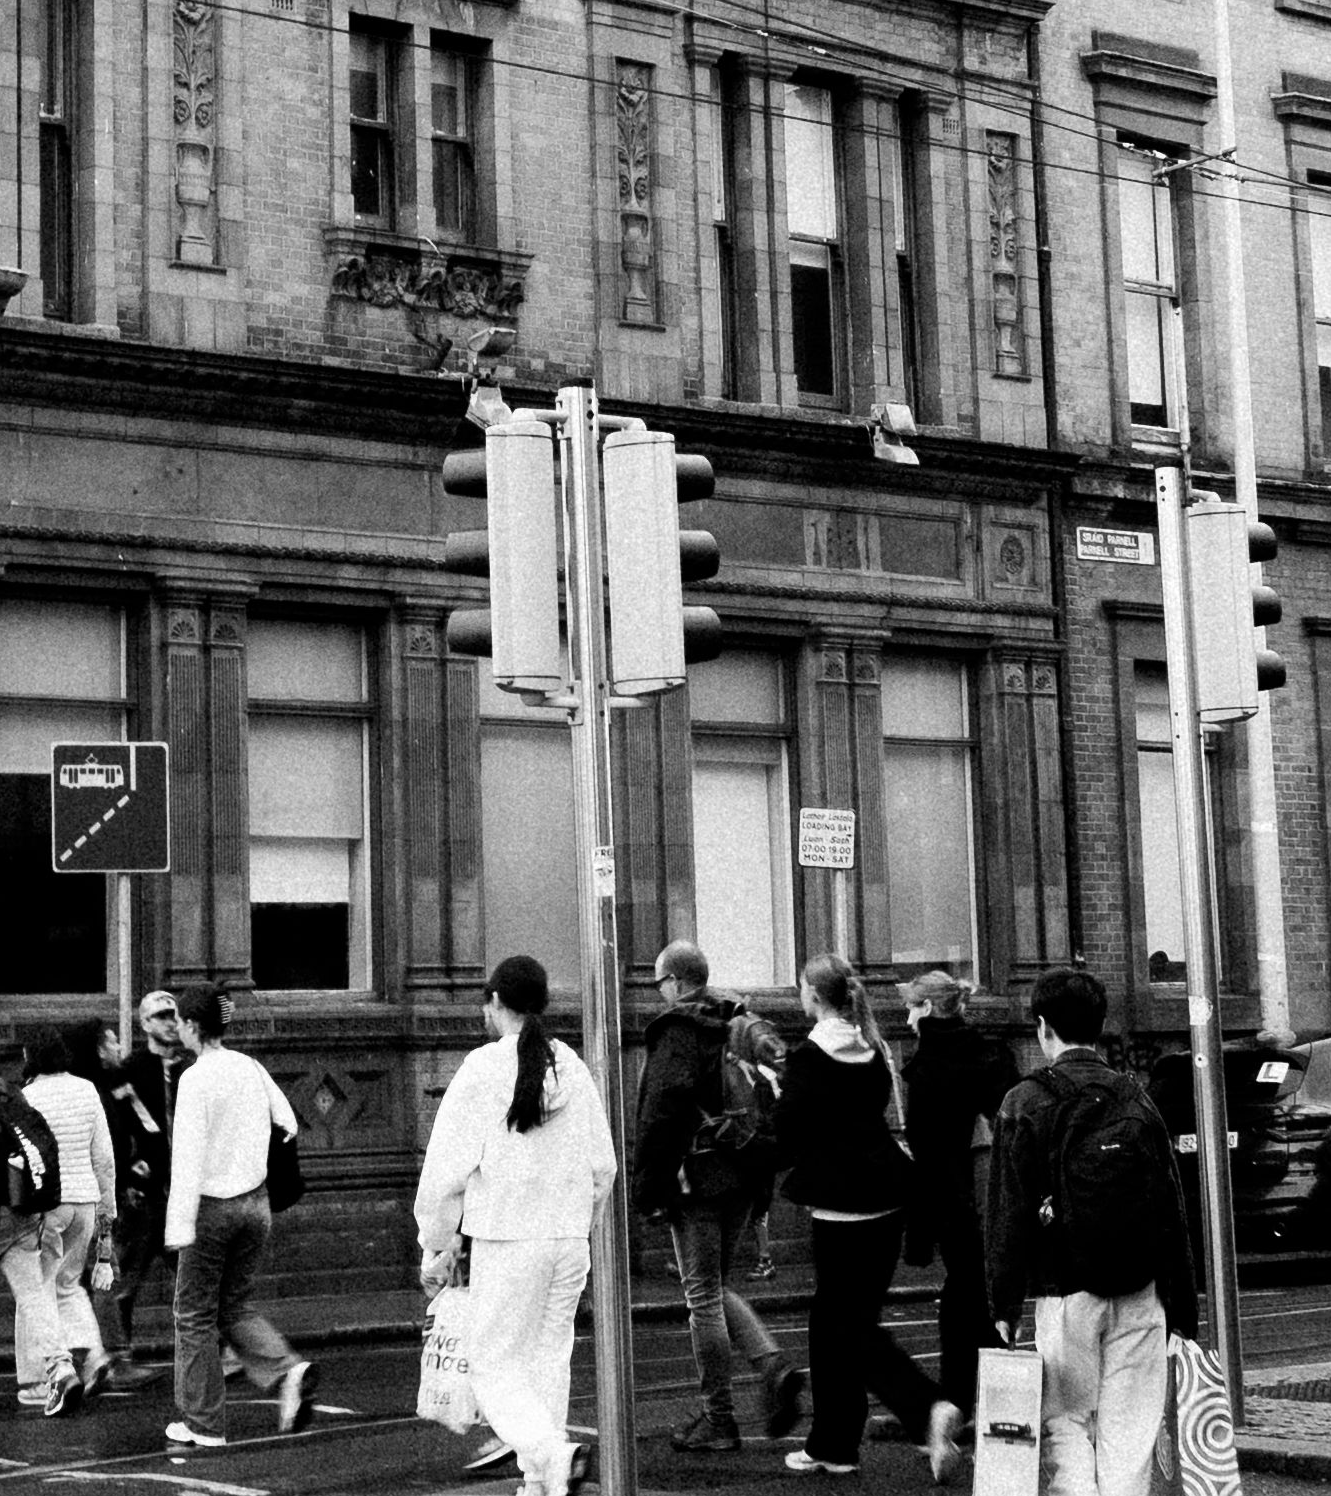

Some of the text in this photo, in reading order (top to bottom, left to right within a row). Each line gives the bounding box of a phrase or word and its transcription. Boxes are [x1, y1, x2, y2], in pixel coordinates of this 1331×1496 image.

[1113, 547, 1140, 559] STREET
[802, 822, 851, 832] LOADING BAY
[804, 854, 849, 864] MON SAT
